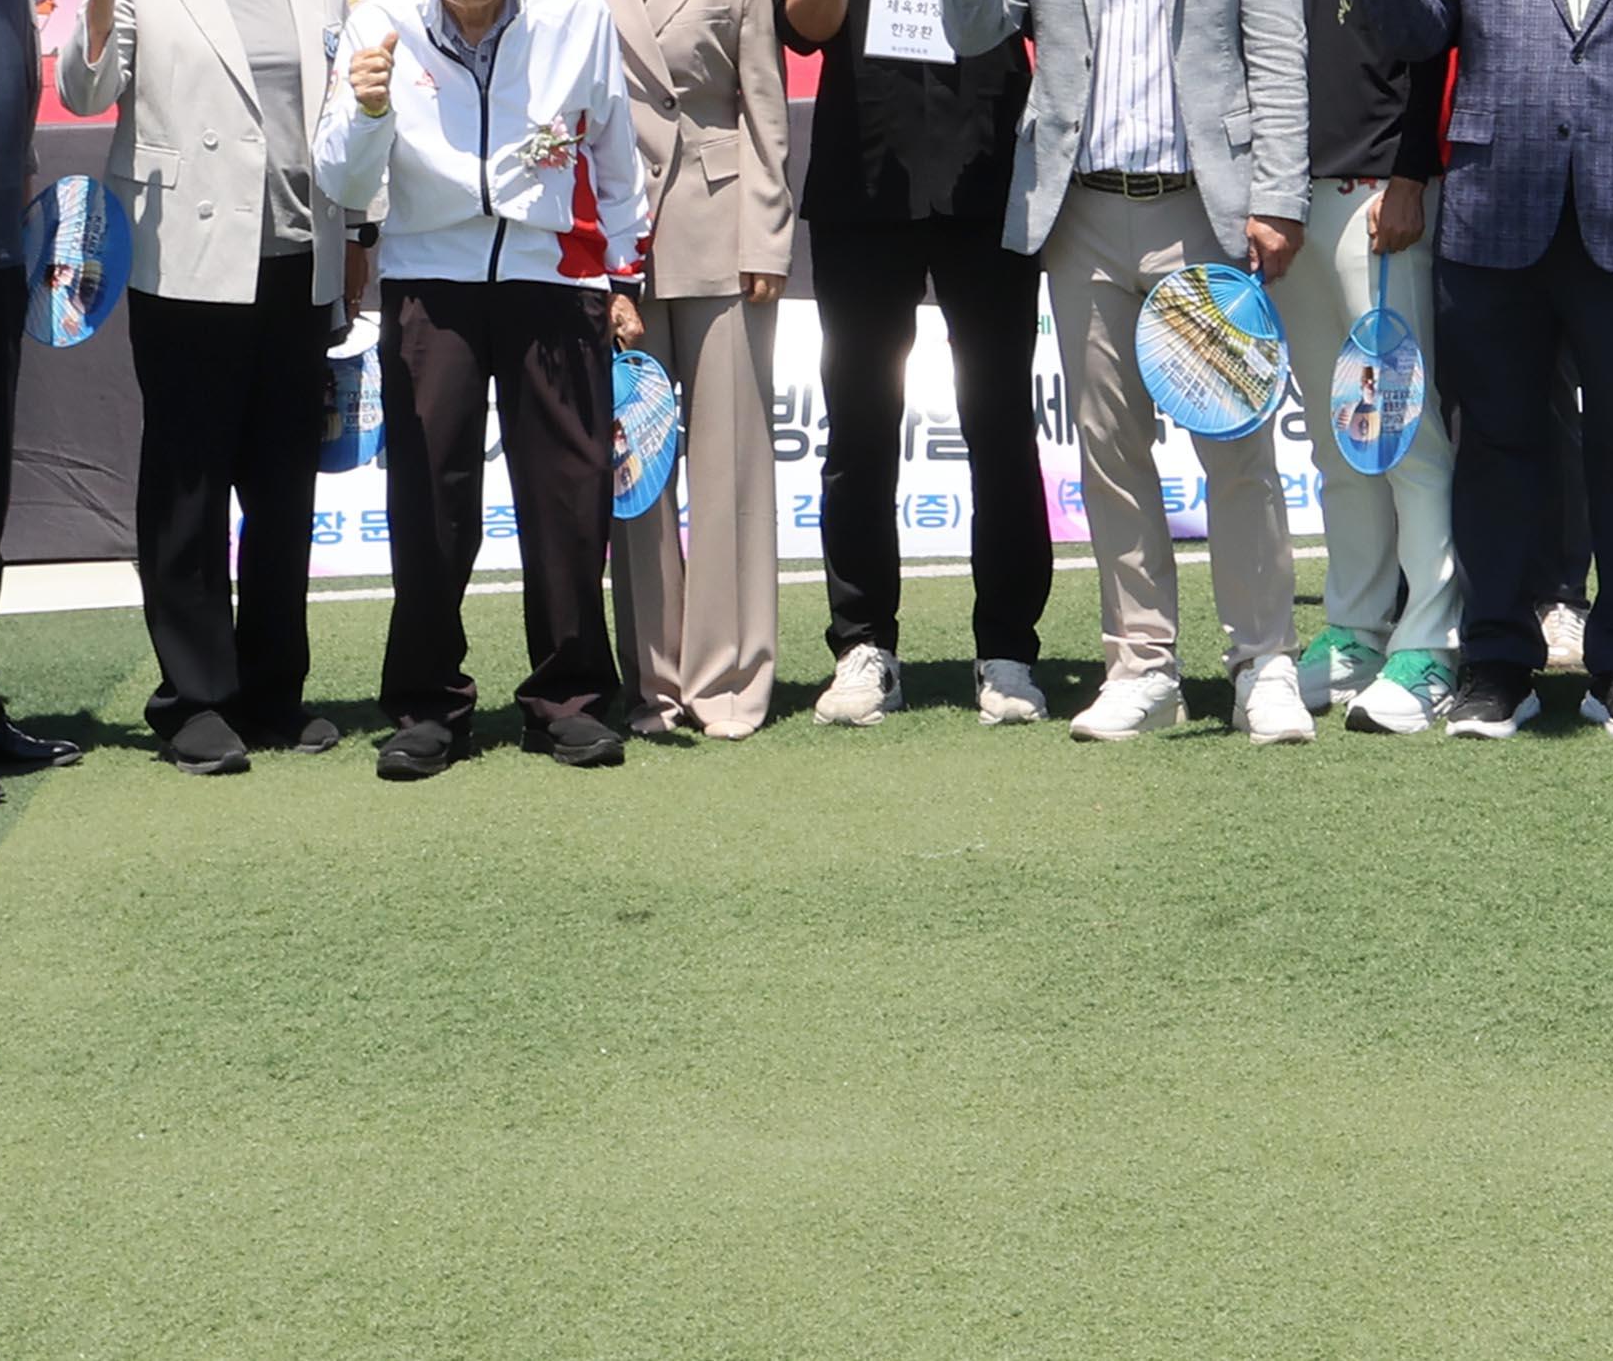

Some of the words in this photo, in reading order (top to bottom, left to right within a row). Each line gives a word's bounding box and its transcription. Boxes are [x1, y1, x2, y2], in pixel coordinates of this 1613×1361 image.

[311, 510, 346, 546] 장
[361, 509, 390, 543] 문
[792, 494, 823, 529] 김
